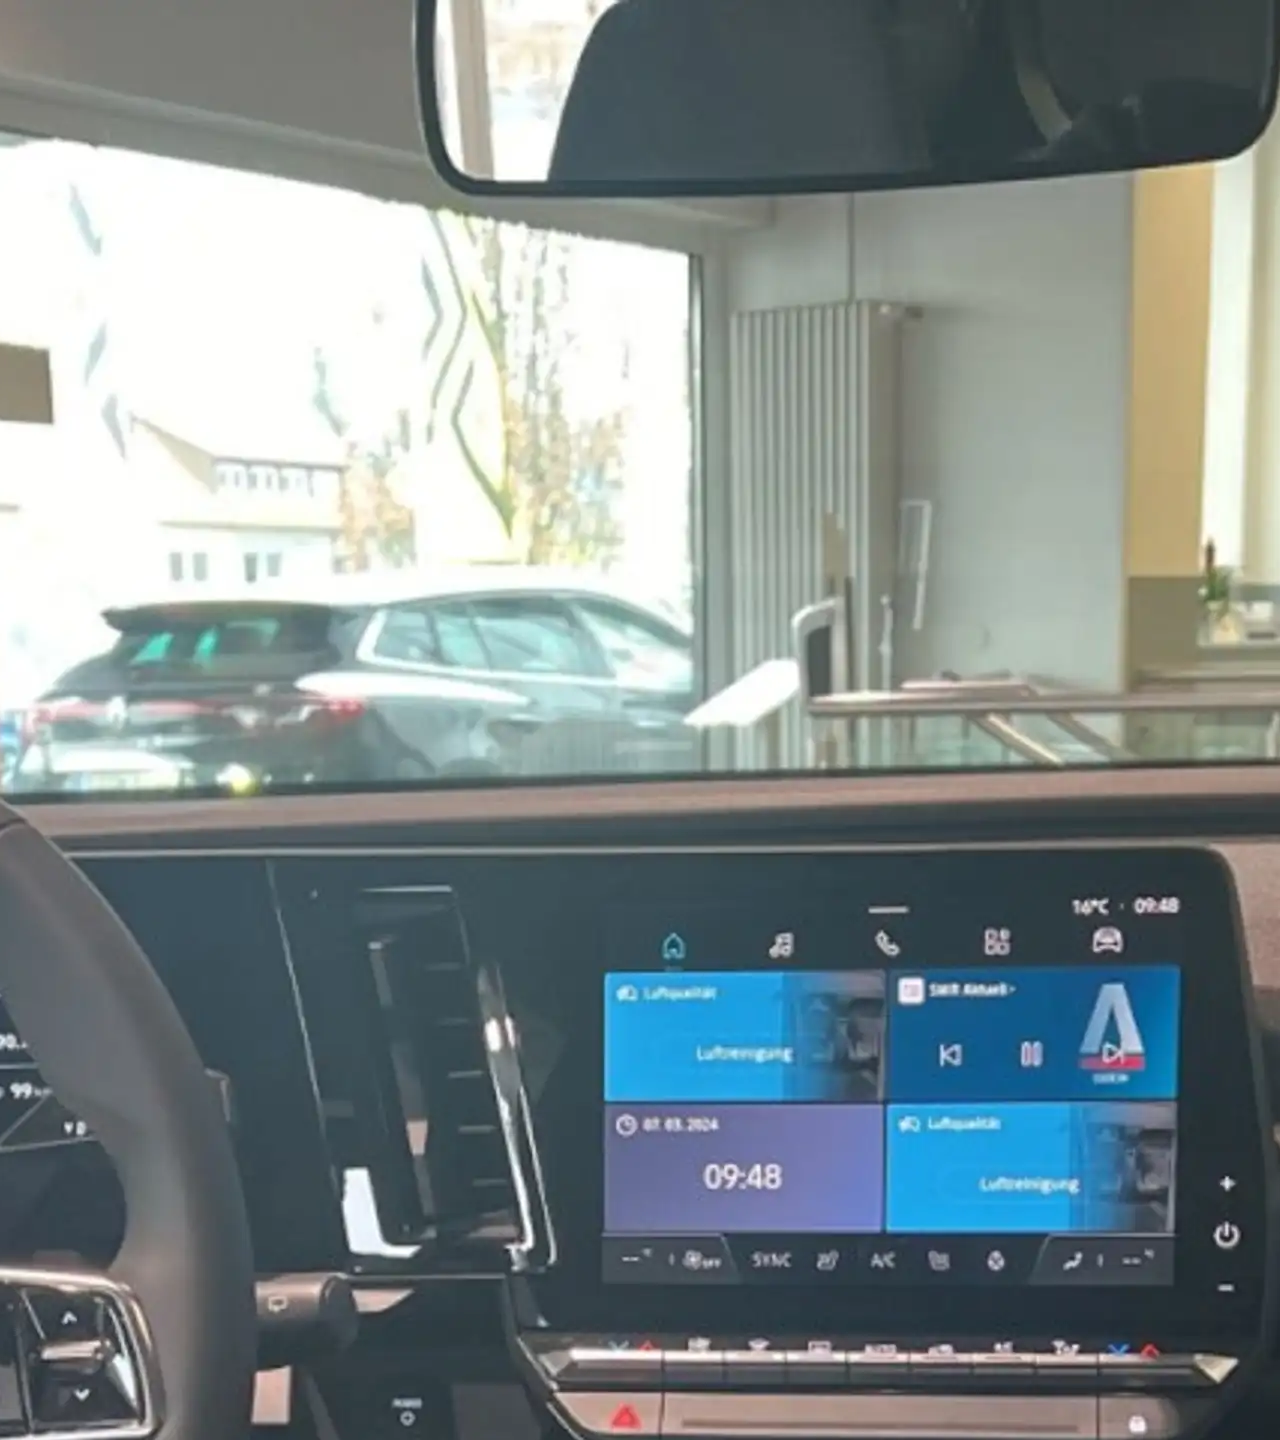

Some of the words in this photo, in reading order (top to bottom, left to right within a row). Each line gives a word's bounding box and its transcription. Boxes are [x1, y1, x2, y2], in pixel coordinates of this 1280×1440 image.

[1133, 897, 1180, 914] 09:48
[696, 1045, 793, 1063] Luftreinigung
[703, 1163, 783, 1190] 09:48
[979, 1176, 1081, 1195] Luftreinigung
[751, 1252, 792, 1268] SYNC
